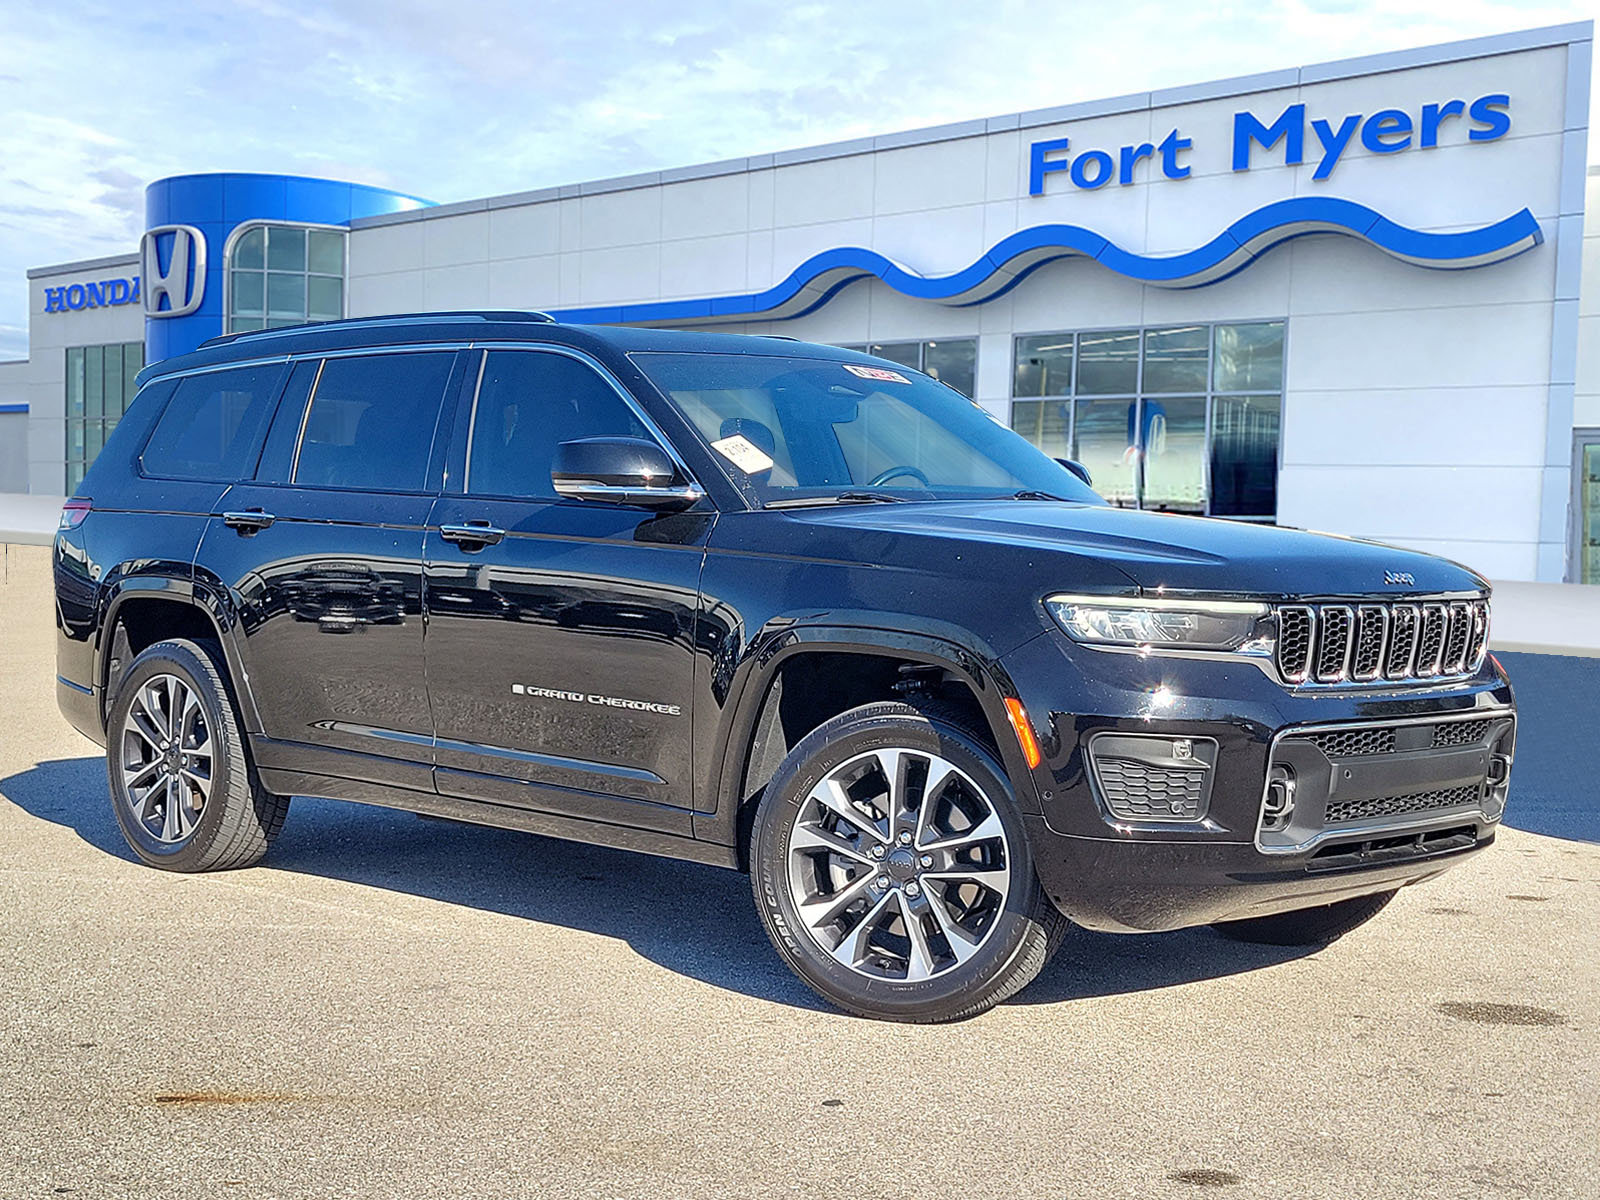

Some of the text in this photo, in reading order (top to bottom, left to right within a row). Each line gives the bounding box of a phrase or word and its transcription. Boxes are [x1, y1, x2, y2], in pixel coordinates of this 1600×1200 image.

[1029, 93, 1512, 196] Fort Myers
[1384, 569, 1415, 586] Jeep
[527, 686, 682, 716] GRAND CHEROKEE
